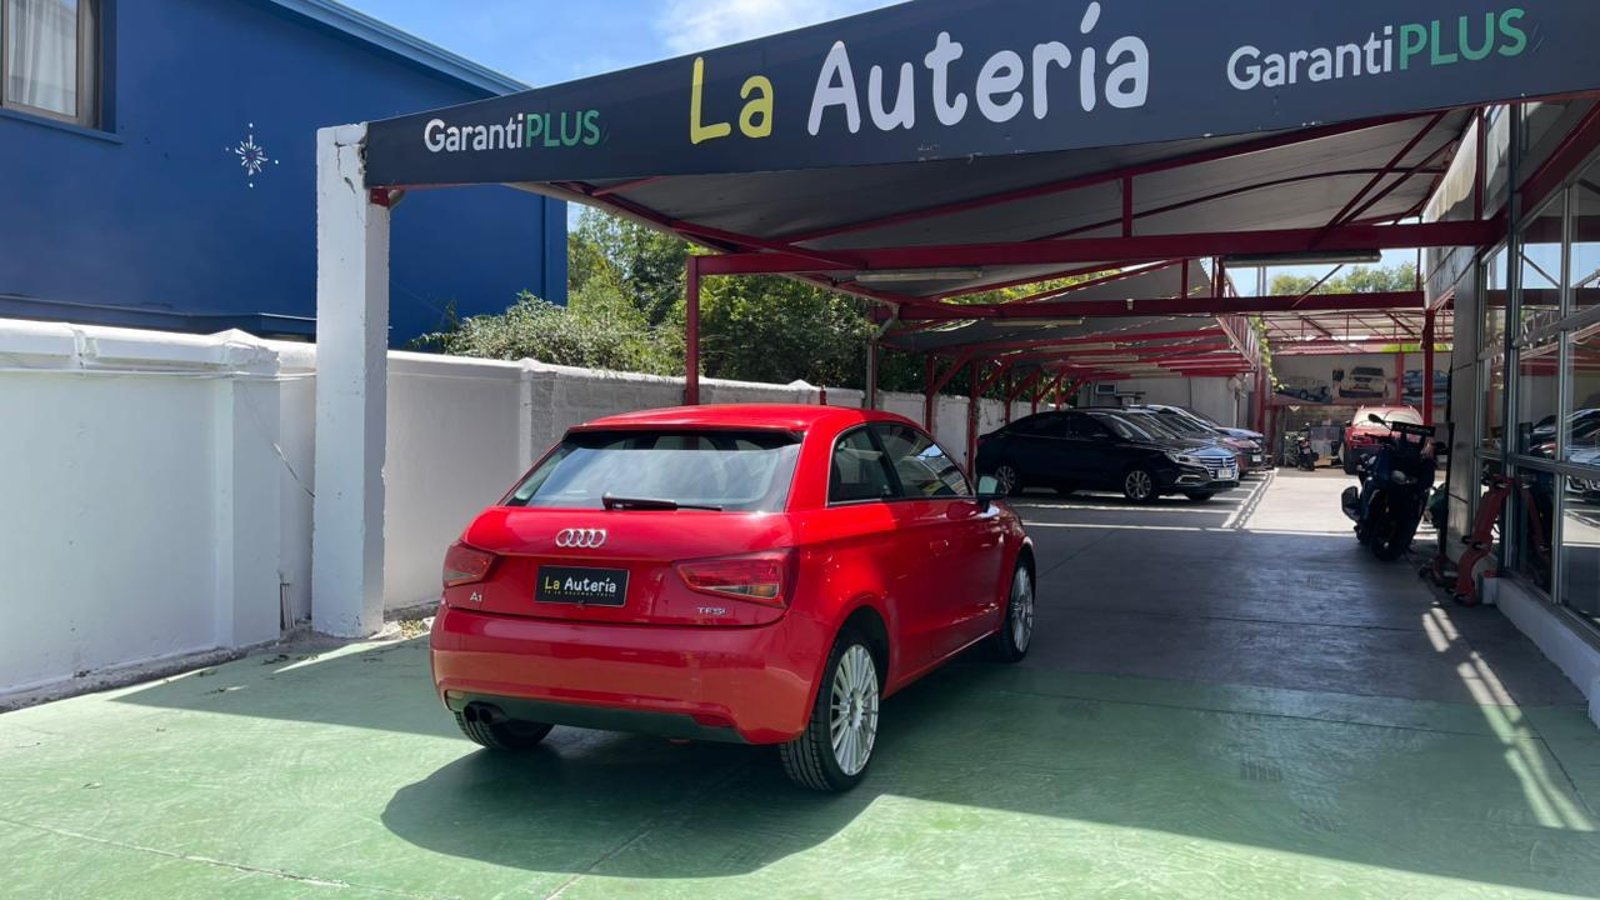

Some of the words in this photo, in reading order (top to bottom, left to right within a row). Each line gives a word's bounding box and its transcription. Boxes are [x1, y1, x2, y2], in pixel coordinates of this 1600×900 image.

[1227, 8, 1528, 90] GarantiPLUS
[690, 57, 774, 144] La
[807, 1, 1149, 136] Autería
[424, 109, 601, 152] GarantiPLUS
[469, 591, 482, 602] A1
[544, 576, 560, 590] La
[564, 577, 616, 593] Autería
